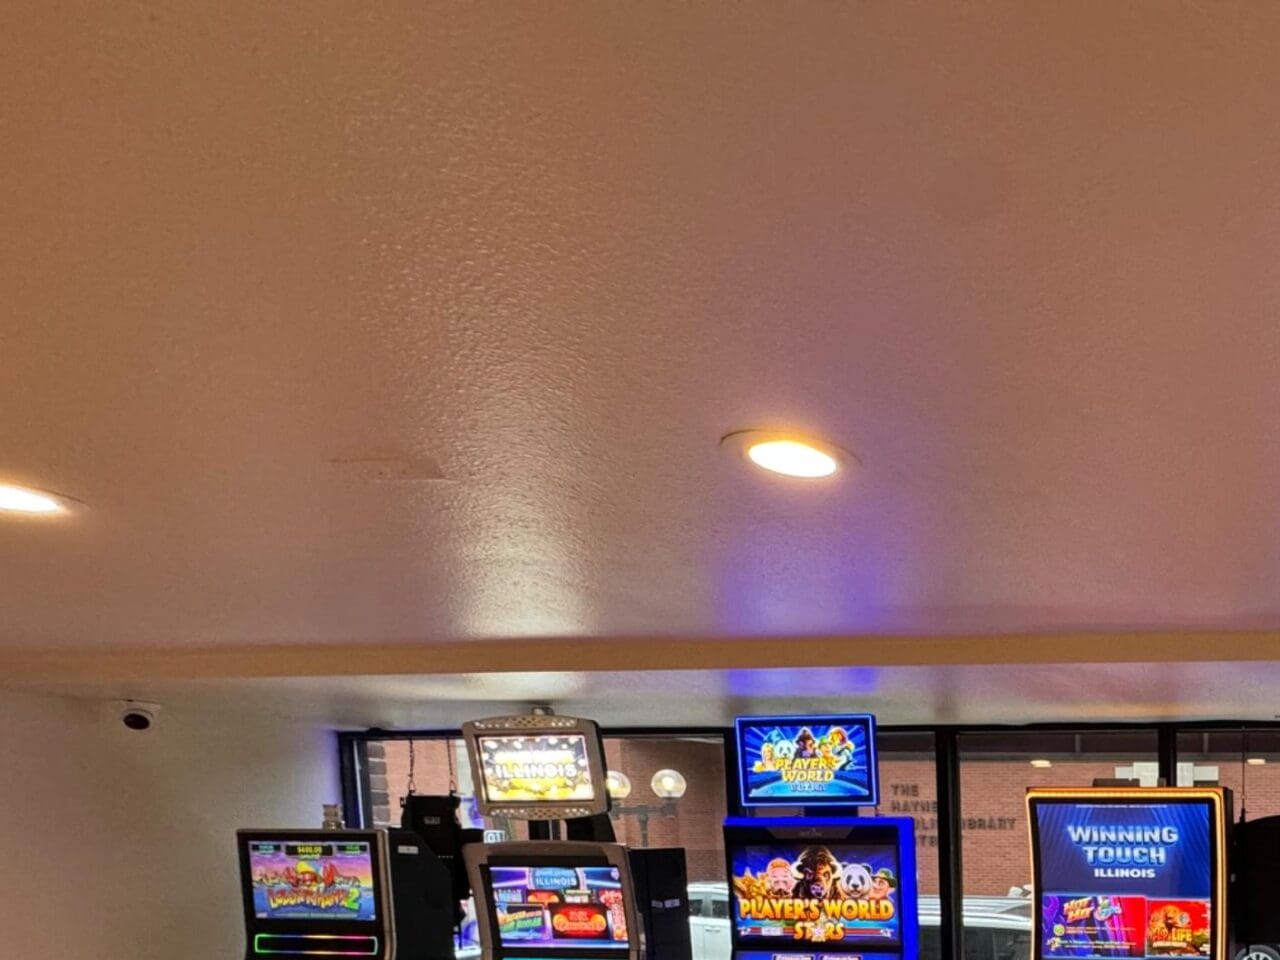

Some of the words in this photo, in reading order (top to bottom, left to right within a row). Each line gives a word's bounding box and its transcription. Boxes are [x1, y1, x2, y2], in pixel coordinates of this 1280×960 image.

[494, 762, 578, 779] ILLINOIS
[782, 770, 834, 782] WORLD
[891, 784, 919, 797] THE
[1067, 825, 1179, 844] WINNING
[1082, 846, 1166, 865] TOUCH
[1094, 868, 1156, 879] ILLINOIS
[739, 899, 820, 920] PLAYER'S
[824, 898, 894, 920] WORLD
